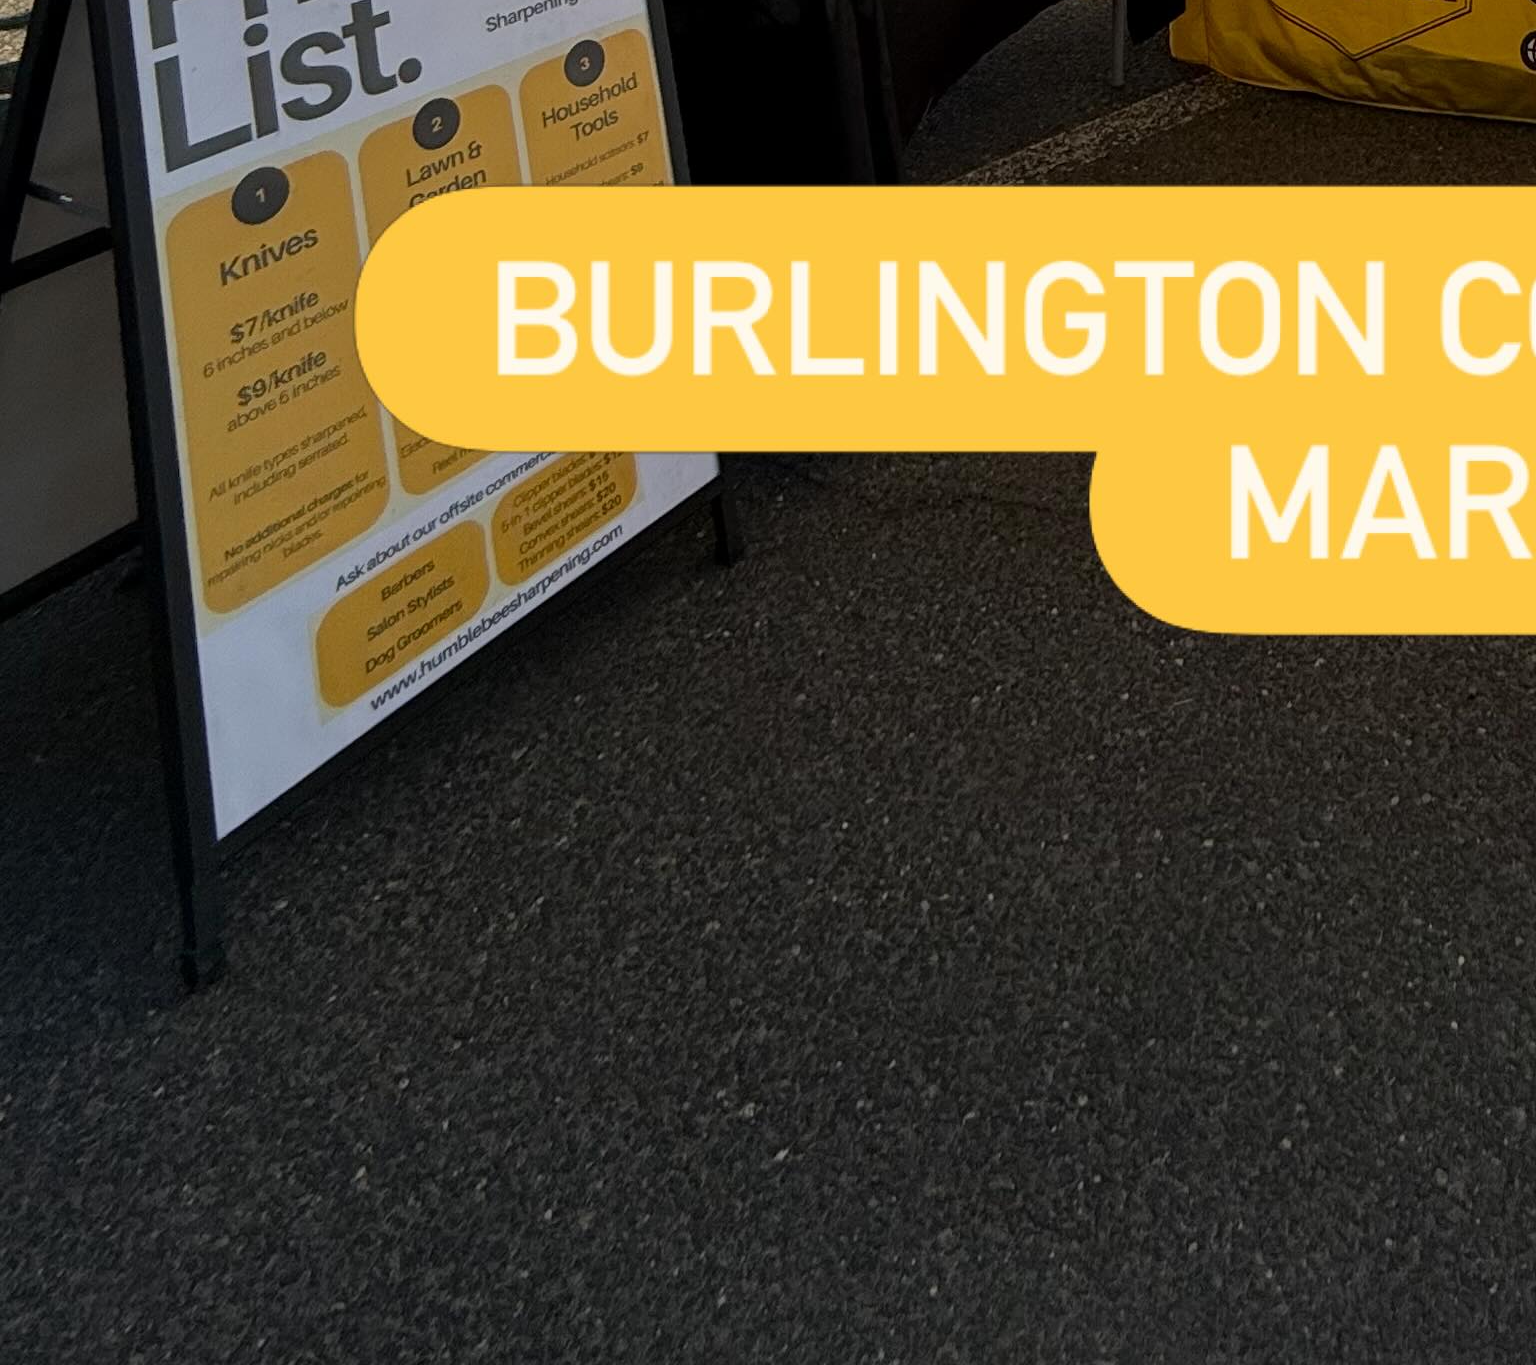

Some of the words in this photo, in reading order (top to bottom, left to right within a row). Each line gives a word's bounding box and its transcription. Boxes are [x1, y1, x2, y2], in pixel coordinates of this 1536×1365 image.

[579, 57, 590, 71] 3
[431, 117, 443, 133] 2
[541, 71, 639, 129] Household
[569, 109, 620, 142] Tools
[405, 148, 465, 188] Lawn
[467, 140, 483, 159] &
[409, 168, 488, 209] Garden
[255, 187, 267, 203] 1
[219, 229, 320, 286] Knives
[202, 364, 214, 379] 6
[216, 340, 269, 373] inches
[271, 319, 302, 345] and
[302, 299, 349, 329] below
[230, 291, 320, 344] $7/knife
[227, 397, 278, 433] above
[291, 365, 342, 398] inches
[237, 349, 327, 407] $9/knife
[209, 482, 227, 502] All
[228, 463, 263, 490] knife
[263, 443, 299, 473] types
[233, 465, 297, 506] including
[224, 545, 244, 562] No
[245, 504, 308, 550] additional
[335, 567, 365, 592] Ask
[367, 533, 411, 569] about
[412, 519, 438, 541] our
[438, 492, 484, 525] offsite
[364, 646, 396, 675] Dog
[396, 599, 464, 652] Groomers
[366, 607, 407, 642] Salon
[407, 575, 456, 615] Stylists
[369, 523, 624, 712] www.humblebeesharpening.com
